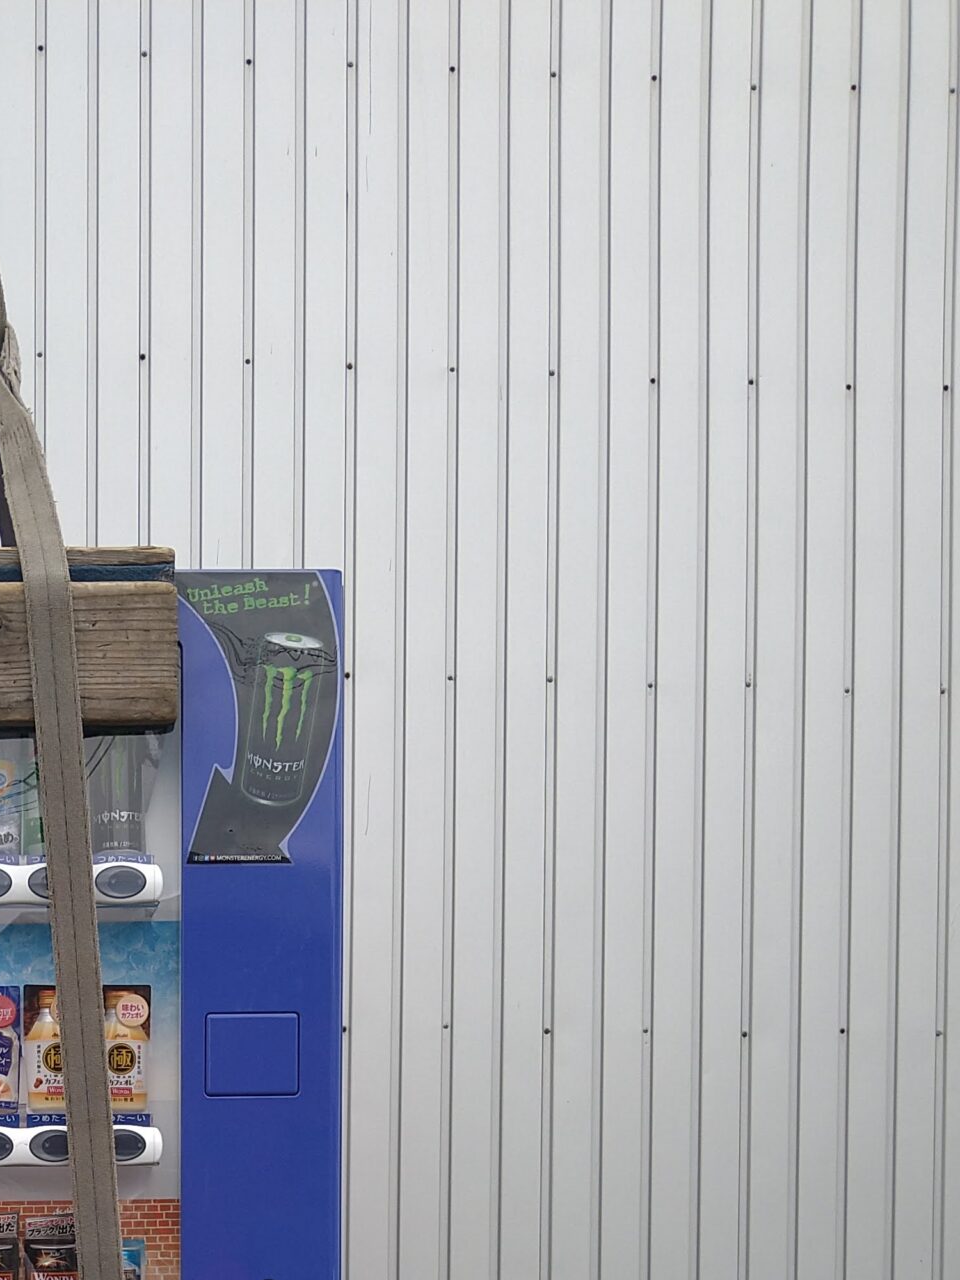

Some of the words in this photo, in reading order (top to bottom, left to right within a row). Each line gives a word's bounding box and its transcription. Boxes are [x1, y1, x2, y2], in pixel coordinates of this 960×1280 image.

[187, 577, 269, 602] Unleash
[203, 600, 238, 615] the
[110, 1047, 132, 1069] 極
